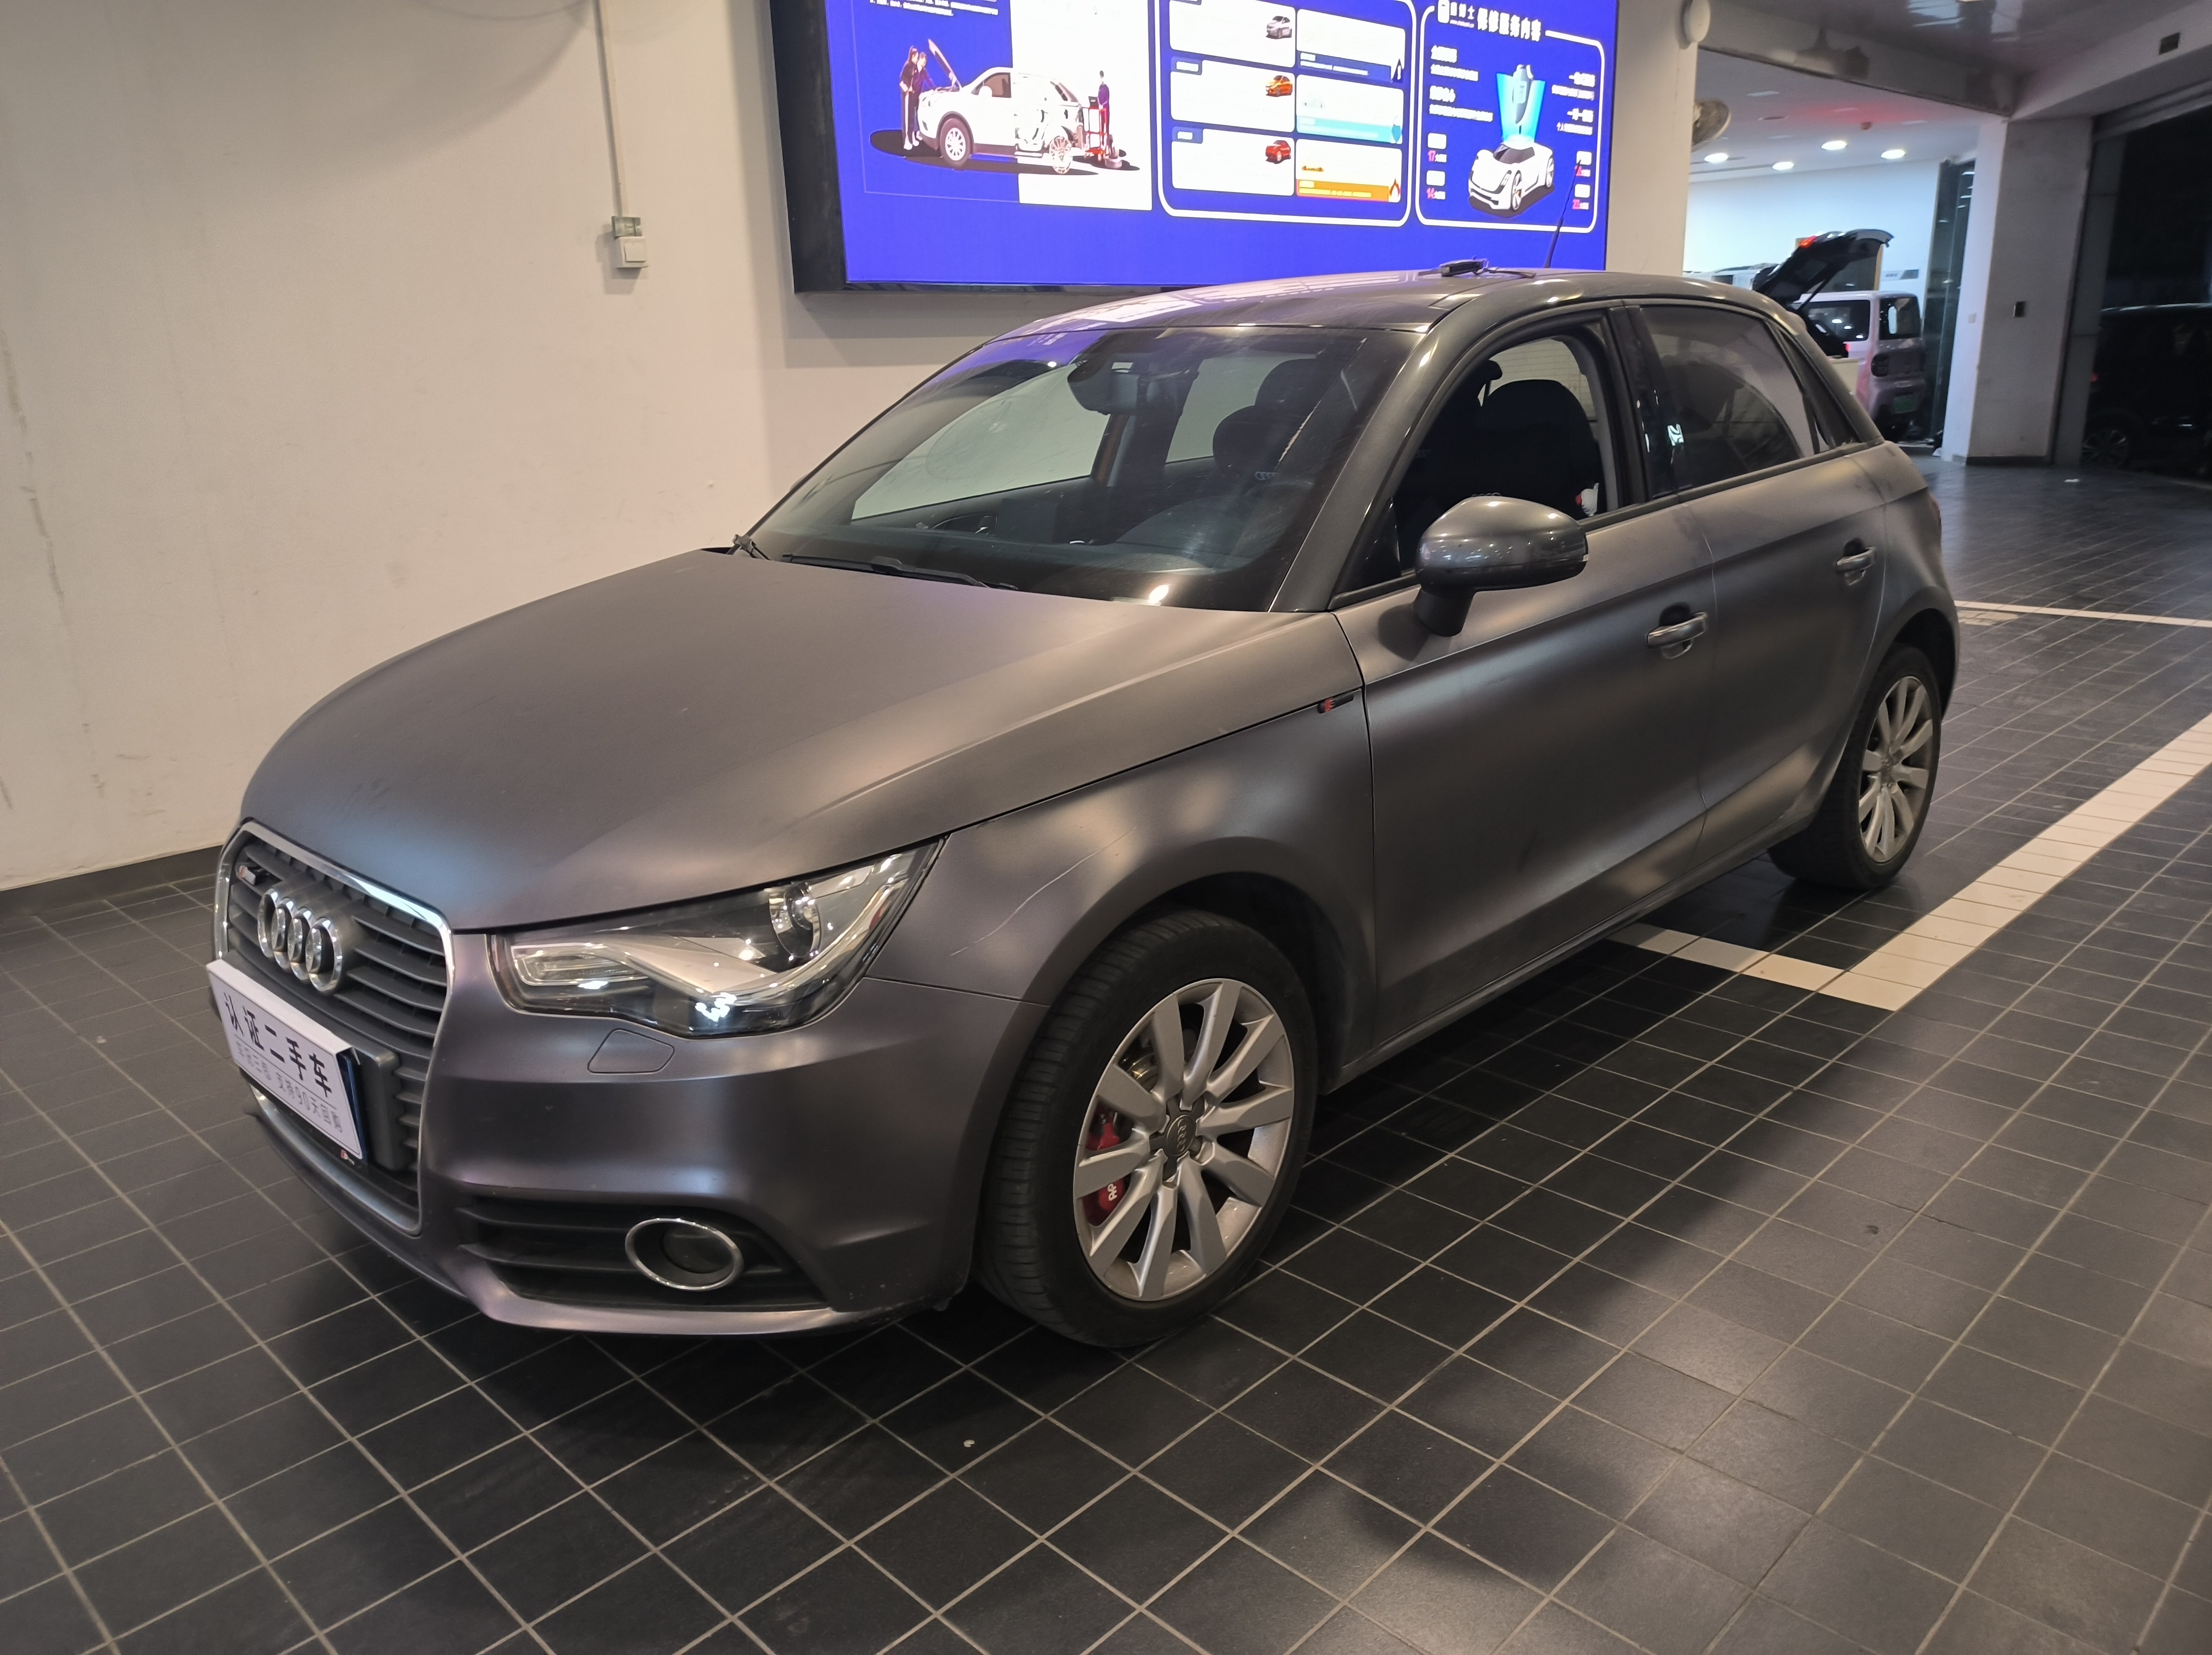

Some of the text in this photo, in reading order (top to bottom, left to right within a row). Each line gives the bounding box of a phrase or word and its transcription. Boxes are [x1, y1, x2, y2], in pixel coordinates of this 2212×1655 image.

[224, 992, 332, 1098] 认证二手车
